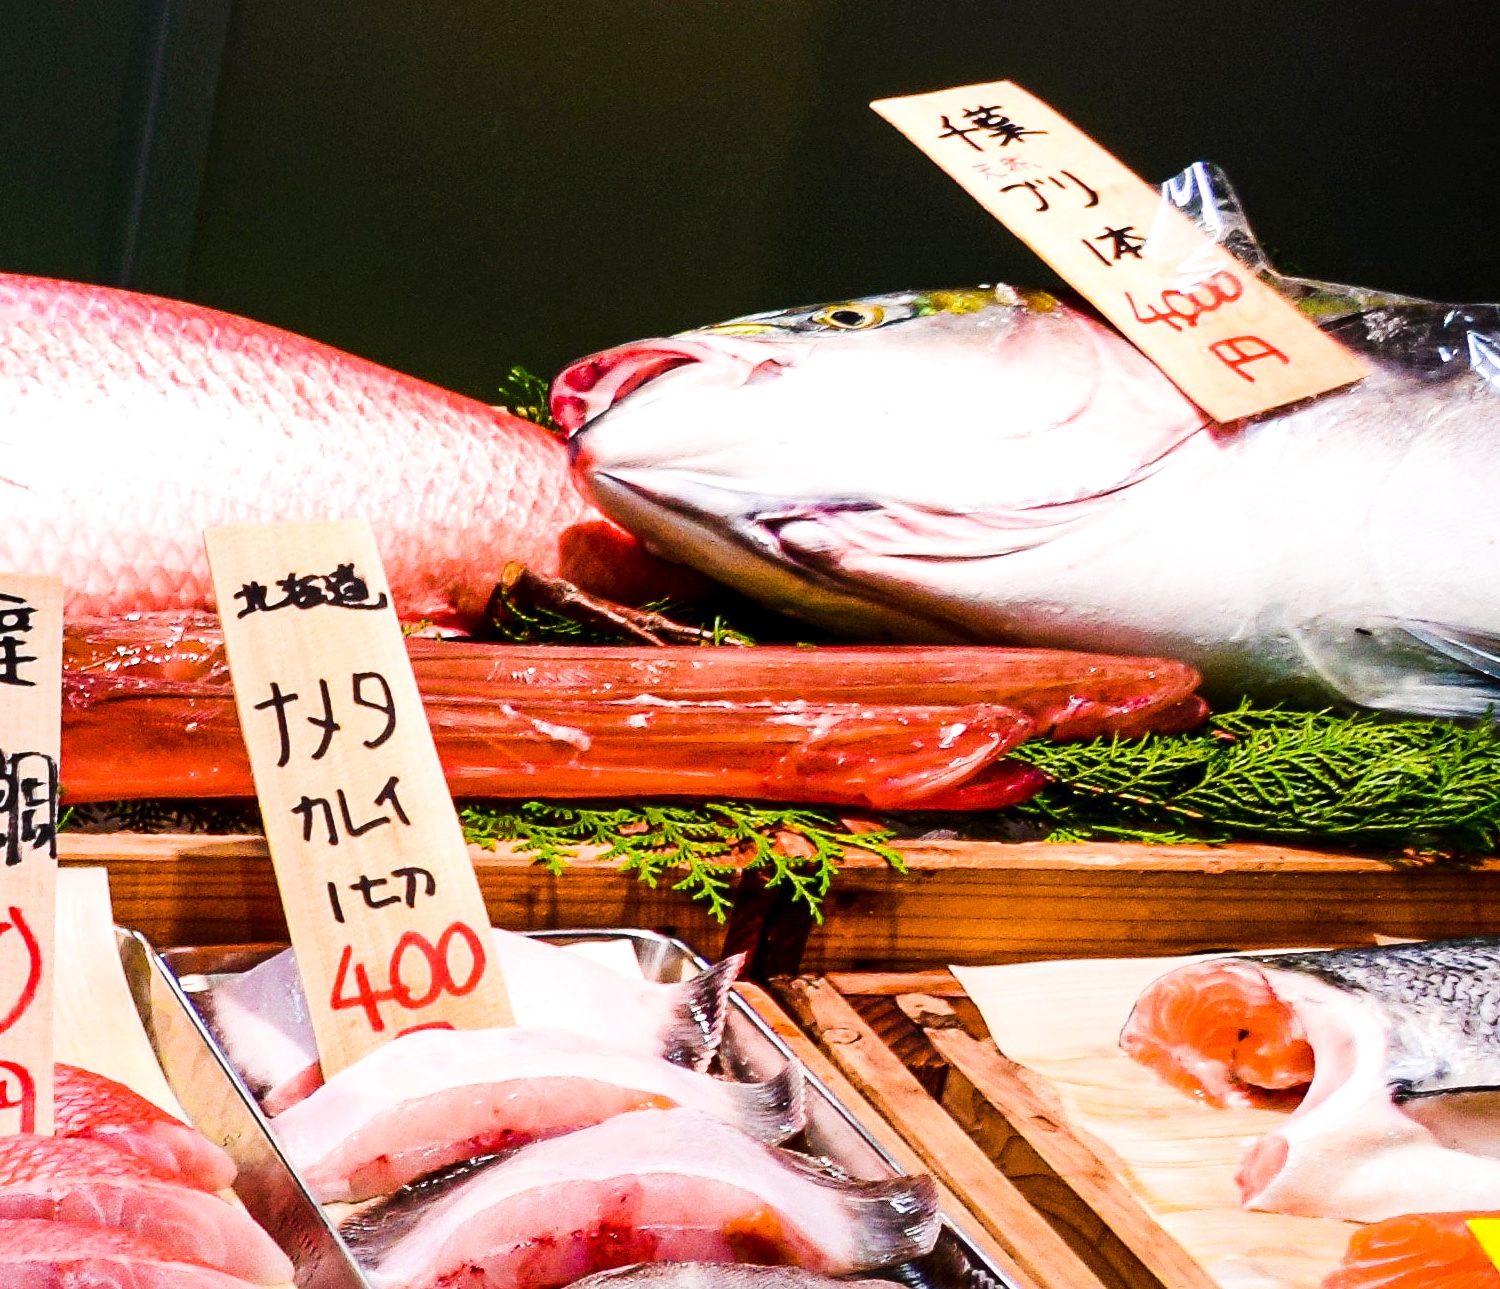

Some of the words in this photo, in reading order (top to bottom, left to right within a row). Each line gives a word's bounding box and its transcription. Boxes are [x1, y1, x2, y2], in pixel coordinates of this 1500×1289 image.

[1209, 335, 1290, 383] 円
[233, 563, 387, 619] 北海道
[254, 672, 397, 767] ナメタ
[291, 776, 410, 846] カレイ
[328, 867, 436, 923] 1切
[331, 921, 486, 1032] 400
